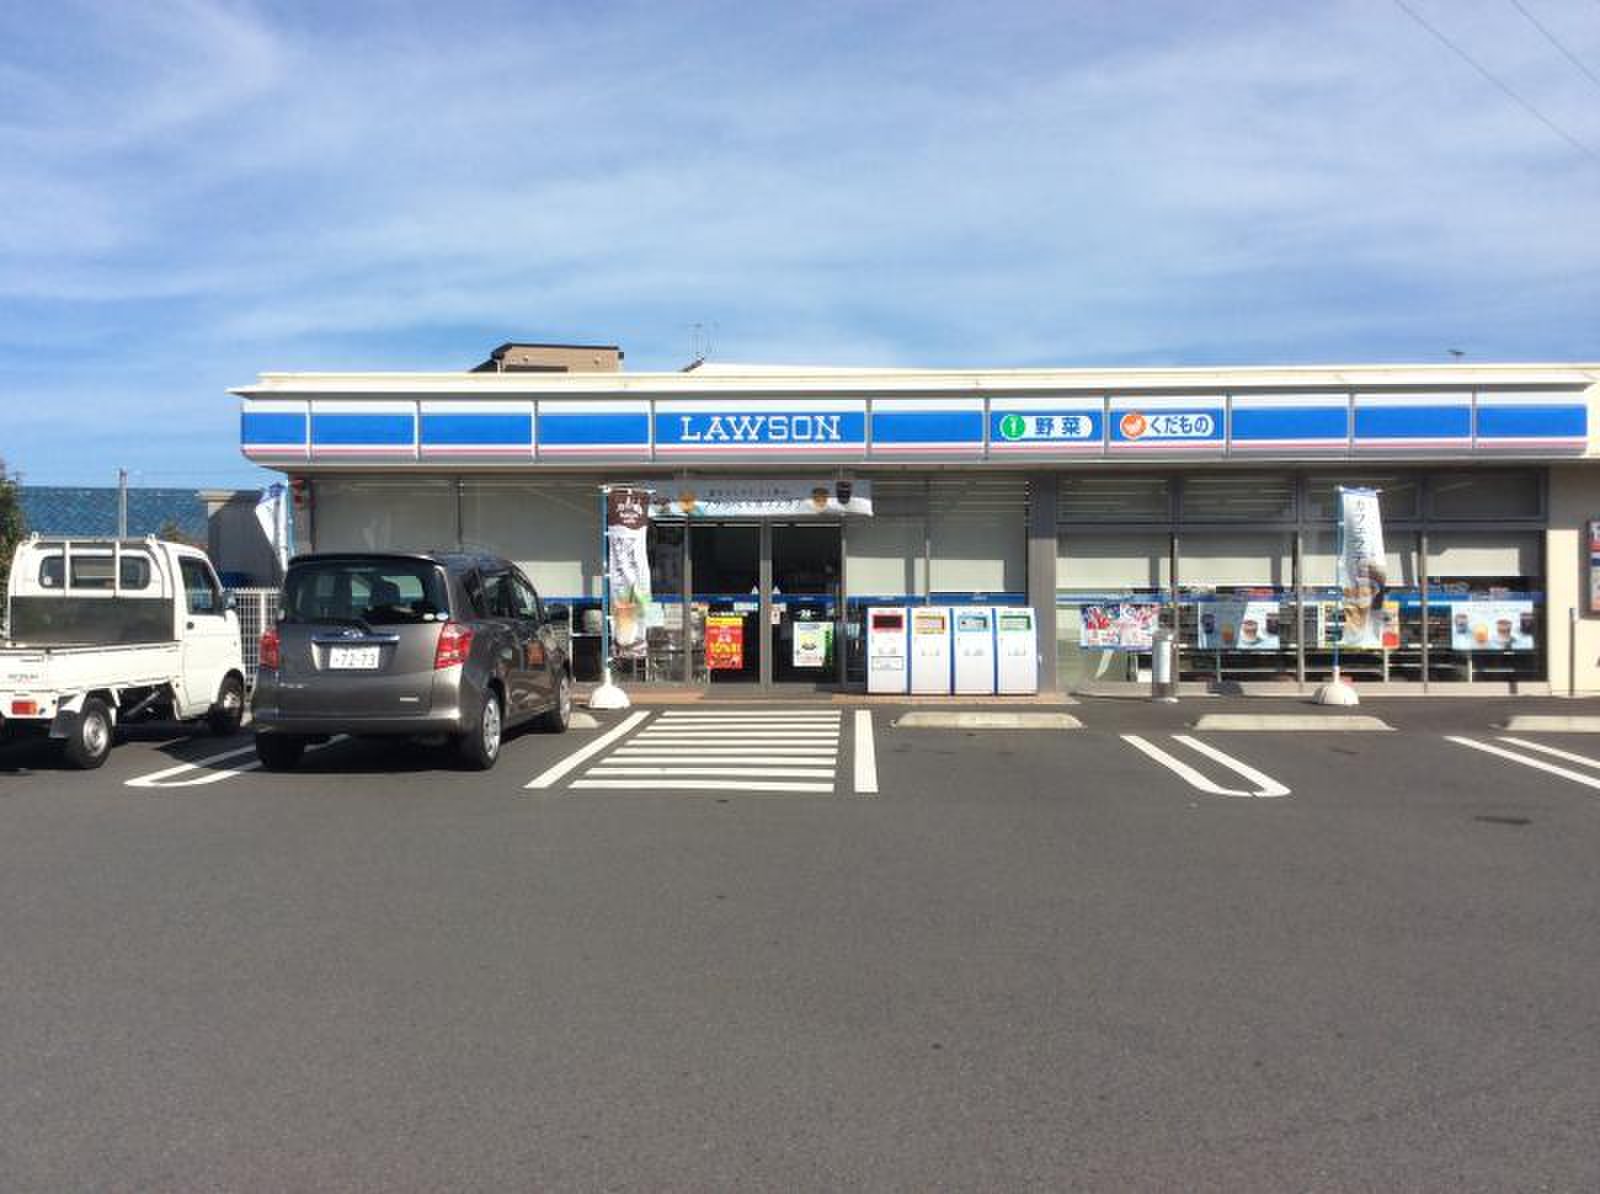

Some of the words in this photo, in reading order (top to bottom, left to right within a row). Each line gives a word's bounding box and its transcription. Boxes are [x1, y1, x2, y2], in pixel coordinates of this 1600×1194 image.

[680, 416, 841, 441] LAWSON
[1034, 416, 1082, 436] 野菜
[1151, 415, 1210, 435] くだもの
